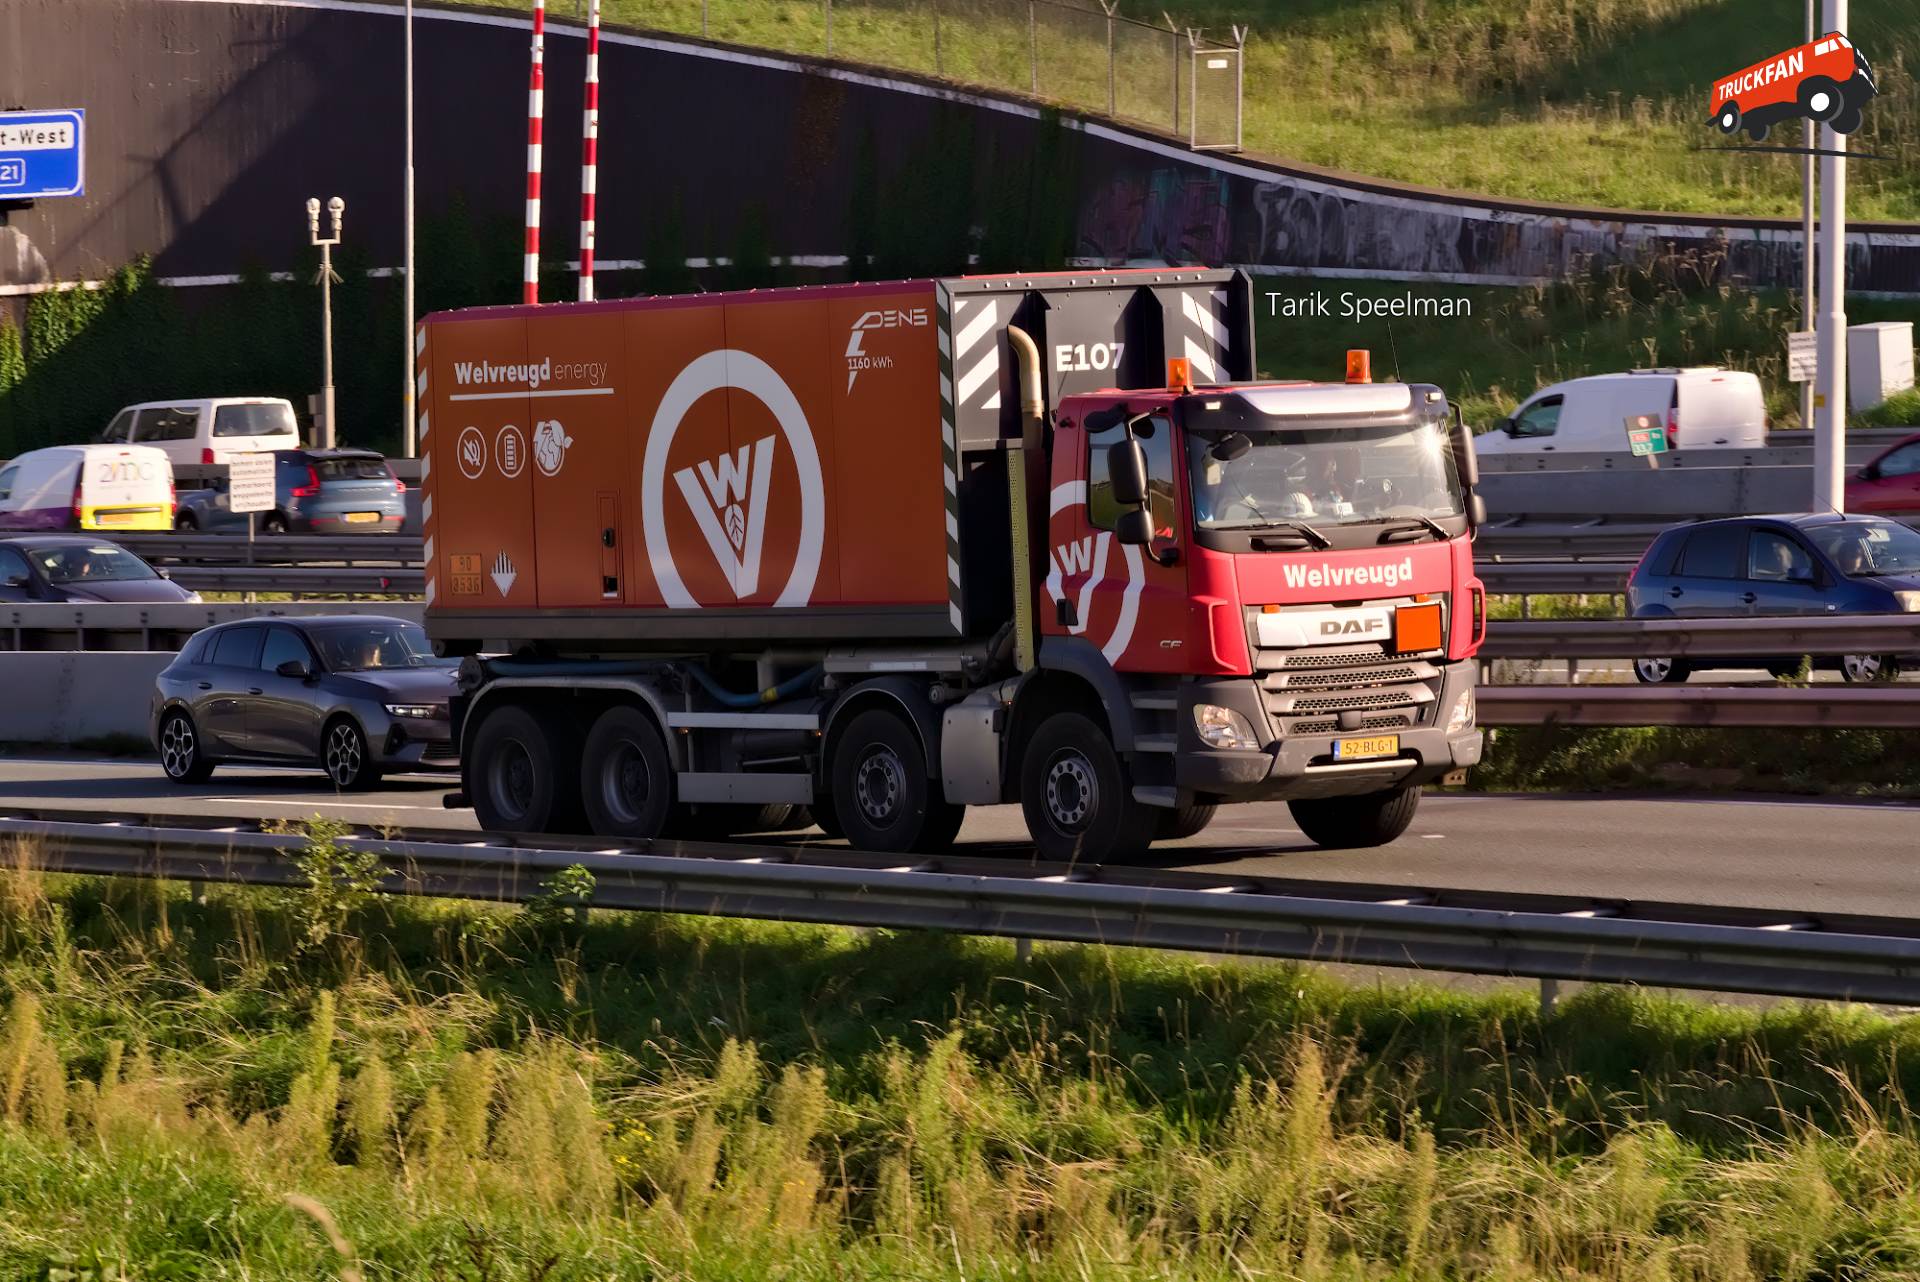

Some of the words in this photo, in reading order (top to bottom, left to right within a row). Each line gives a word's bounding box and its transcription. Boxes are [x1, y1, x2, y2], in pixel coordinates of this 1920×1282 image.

[848, 357, 870, 370] 1160
[872, 356, 893, 369] kWh
[1056, 342, 1125, 373] E107
[454, 356, 551, 389] Welvreugd
[554, 361, 607, 387] energy
[1283, 557, 1413, 589] Welvreugd
[1319, 617, 1384, 636] DAF
[1159, 639, 1182, 649] CF
